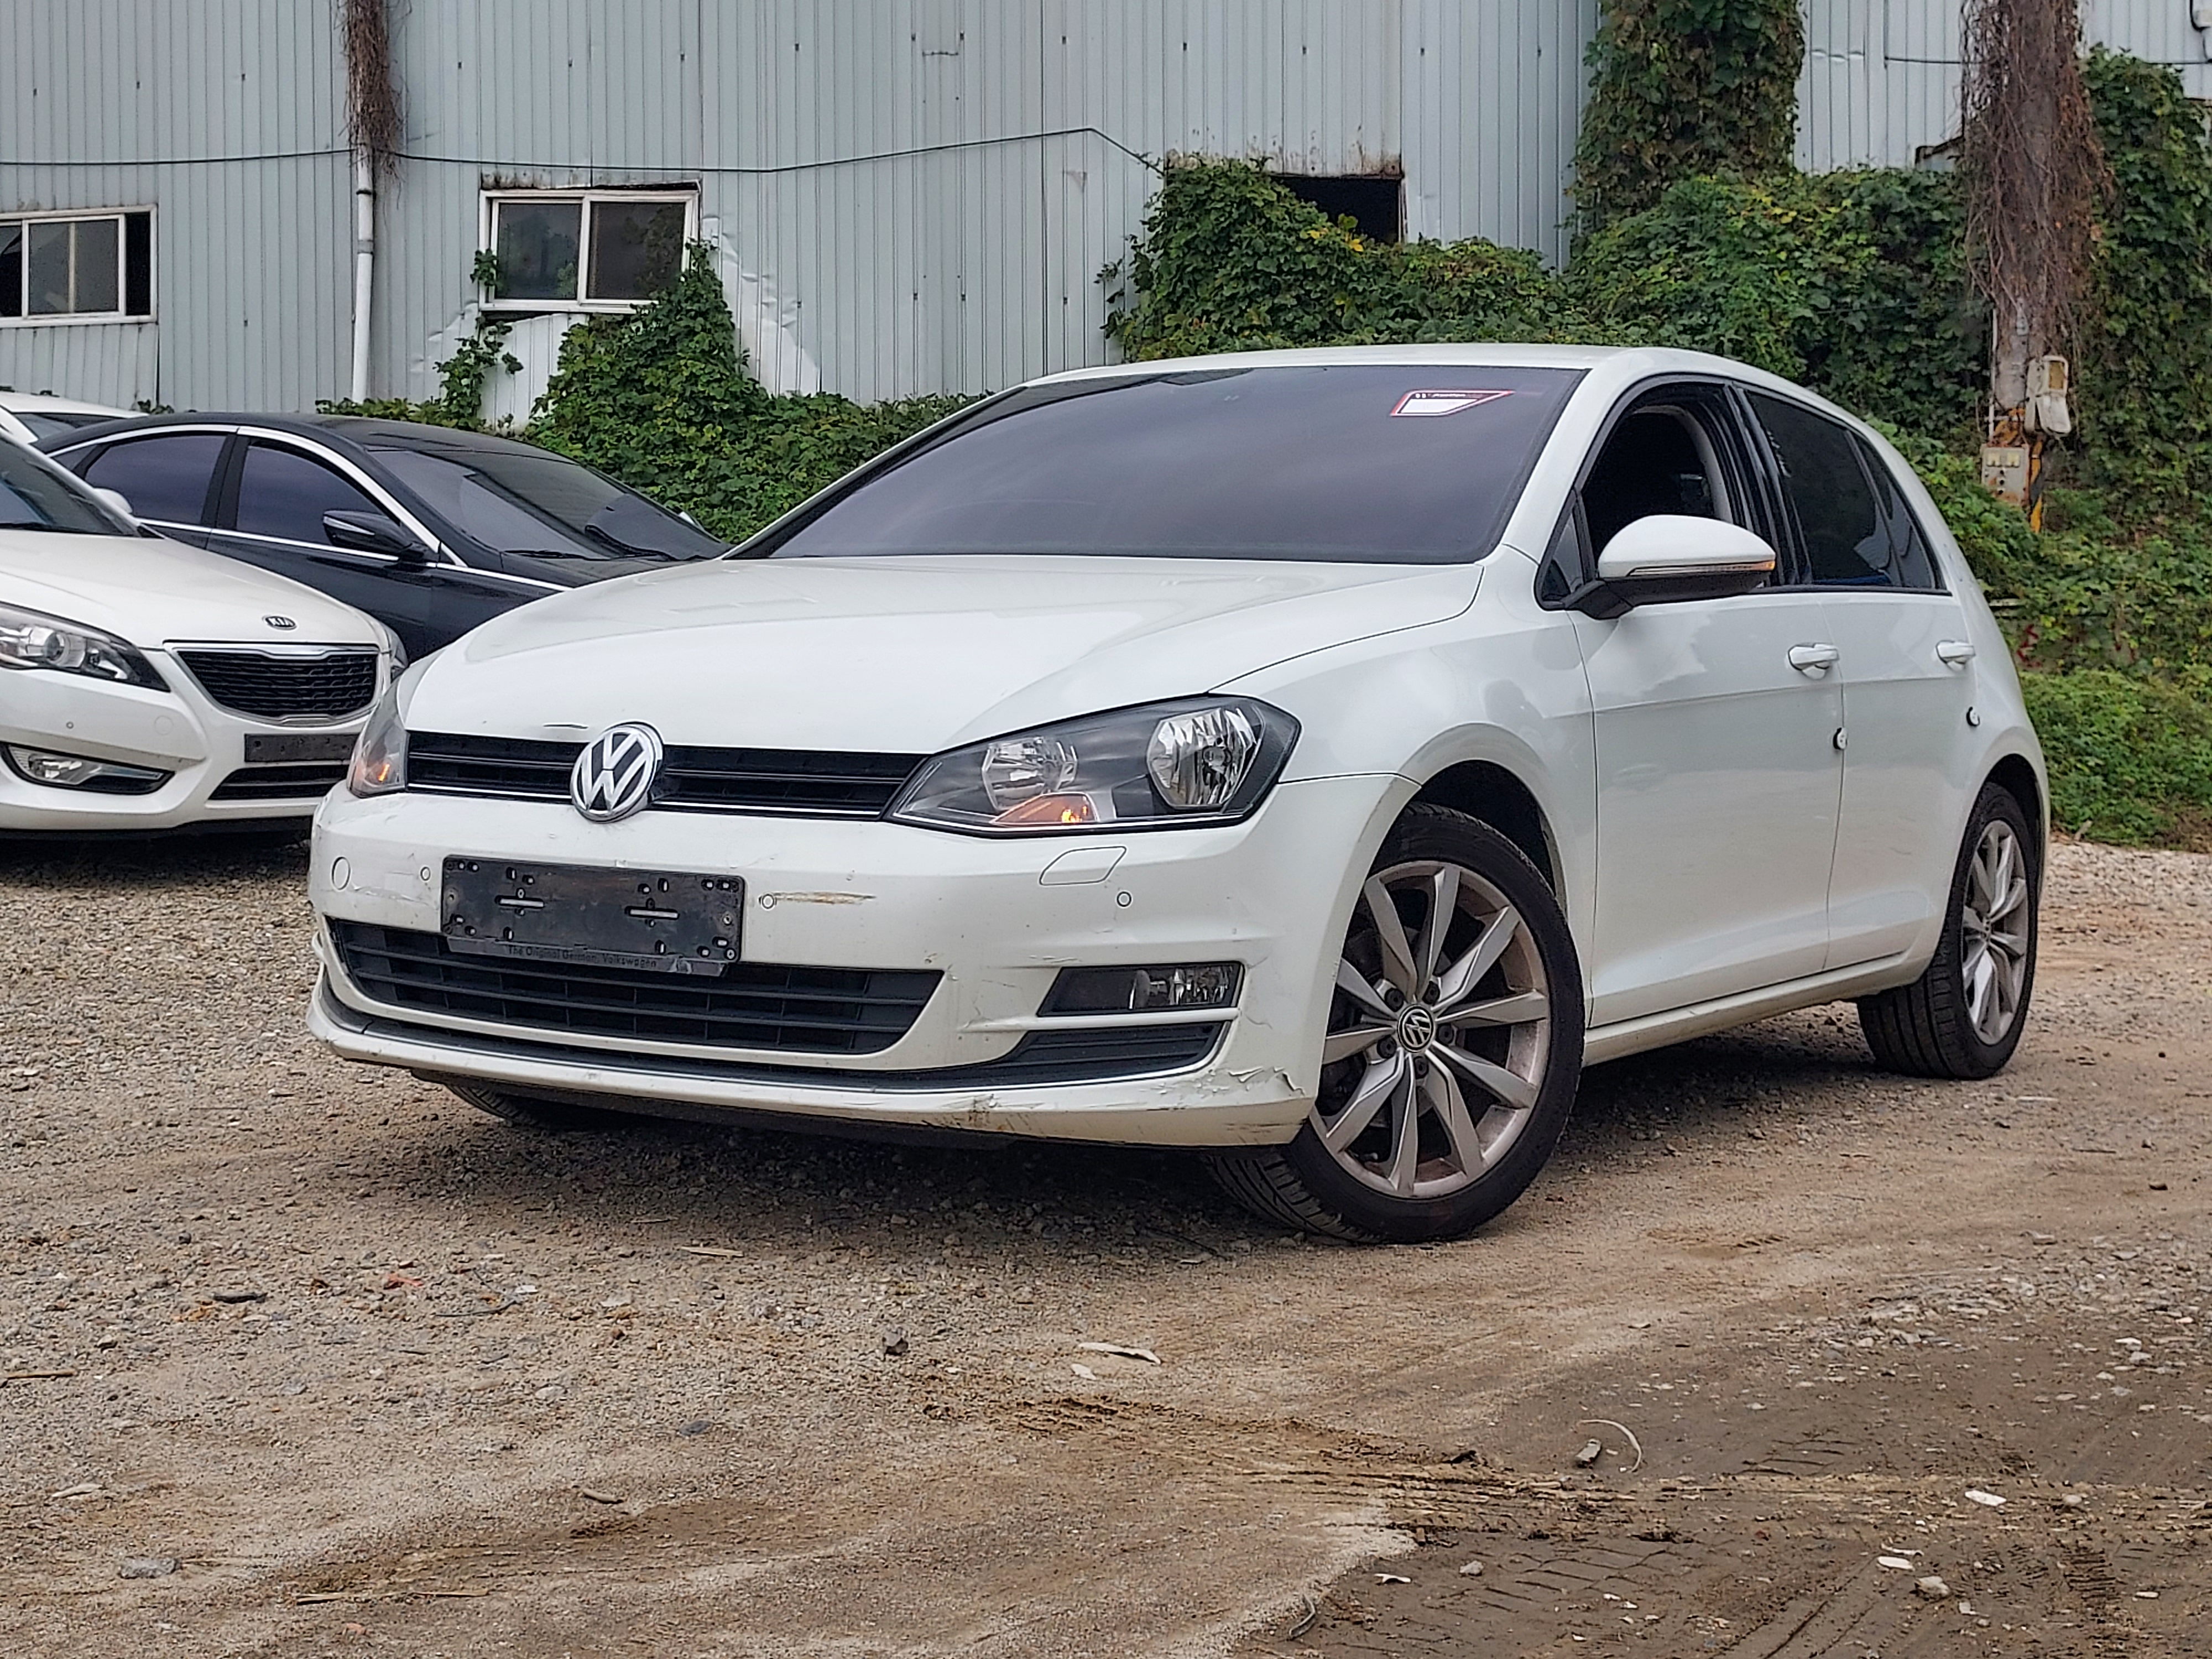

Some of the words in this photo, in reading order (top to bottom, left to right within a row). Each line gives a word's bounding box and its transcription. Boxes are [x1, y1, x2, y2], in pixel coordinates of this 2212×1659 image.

[267, 617, 295, 627] KIA
[572, 726, 655, 814] VW
[508, 944, 523, 955] The
[526, 946, 560, 960] Original
[602, 953, 657, 968] Volkswagen
